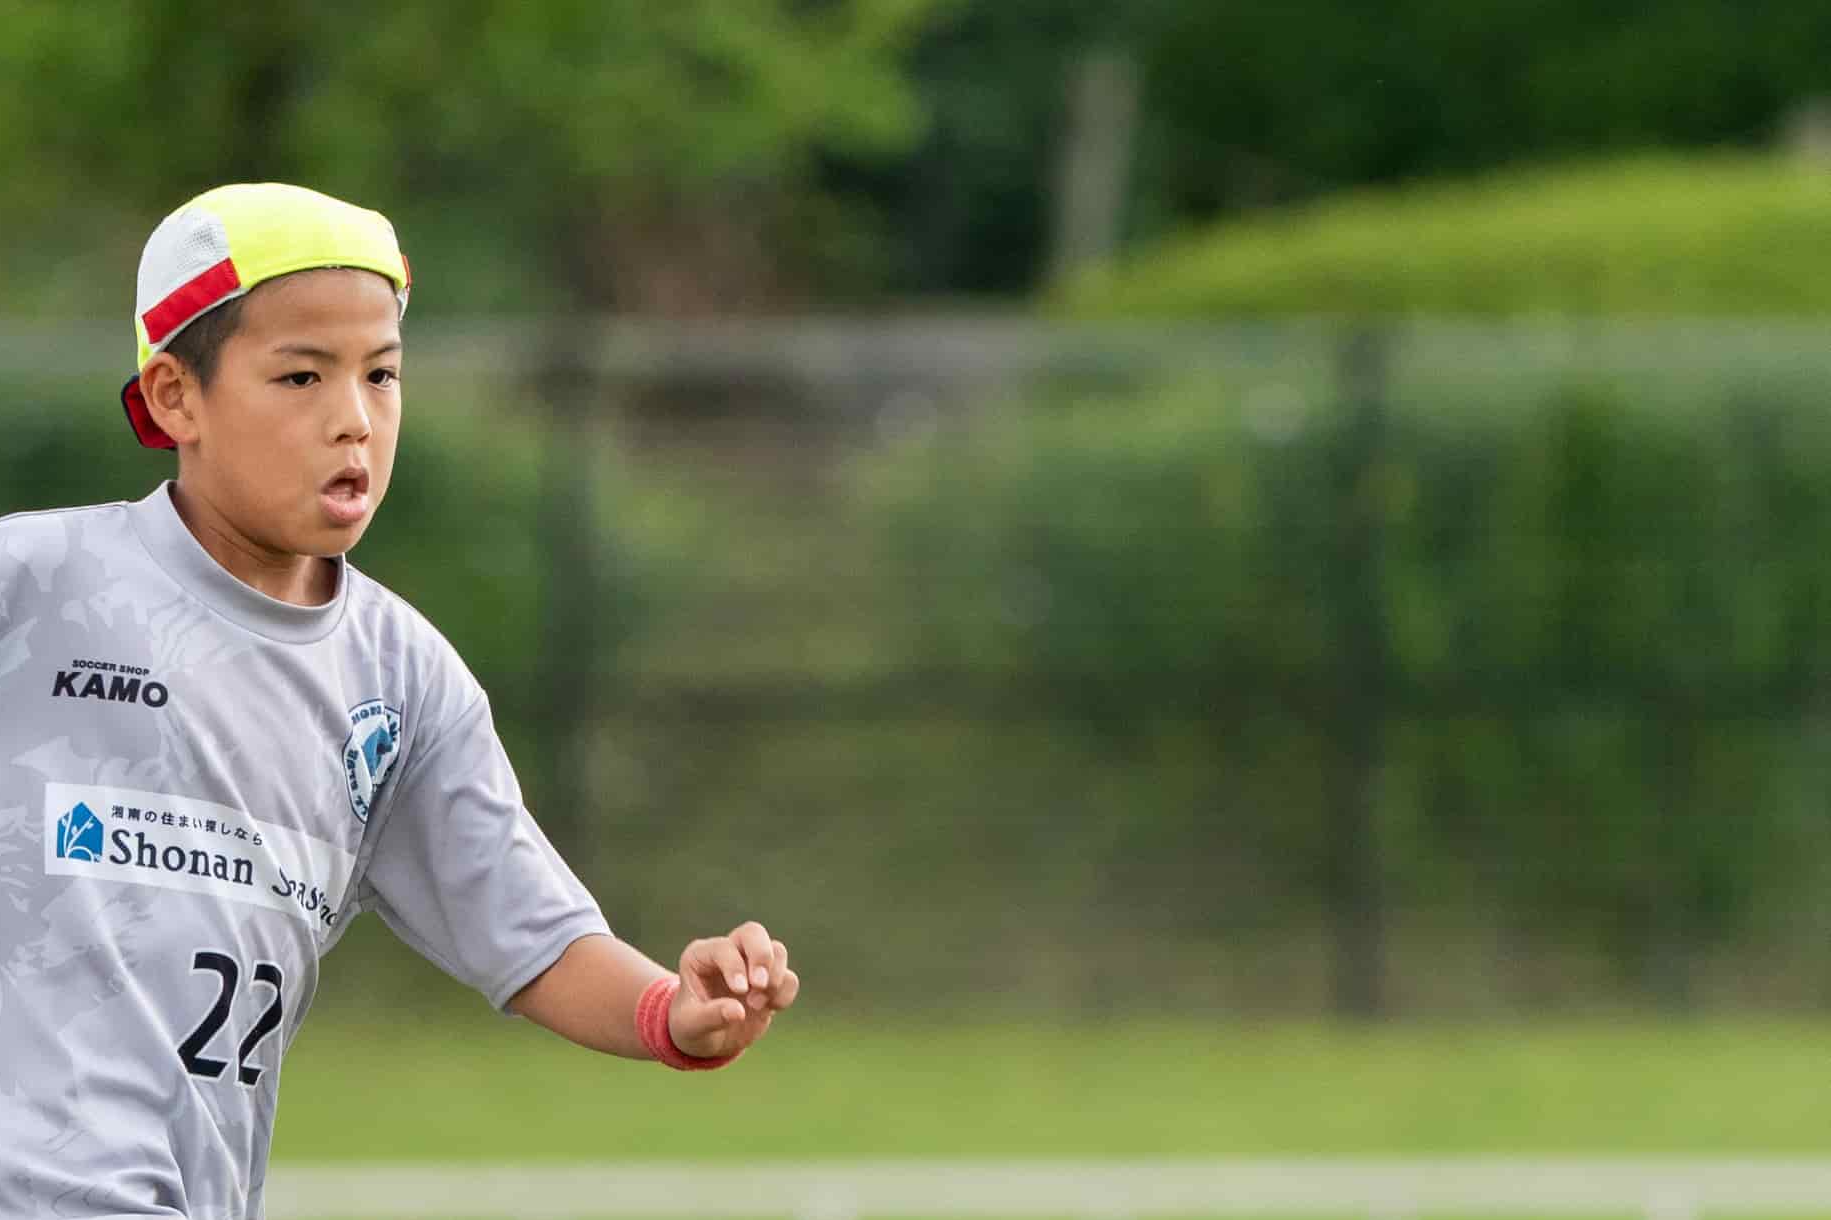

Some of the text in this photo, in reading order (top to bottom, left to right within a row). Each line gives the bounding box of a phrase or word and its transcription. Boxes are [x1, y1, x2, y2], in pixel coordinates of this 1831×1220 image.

[72, 659, 150, 676] SOCCER SHOP
[52, 671, 168, 708] KAMO
[111, 805, 263, 846] 湘南の住まい探しなら
[109, 828, 254, 886] Shonan
[176, 951, 284, 1087] 22
